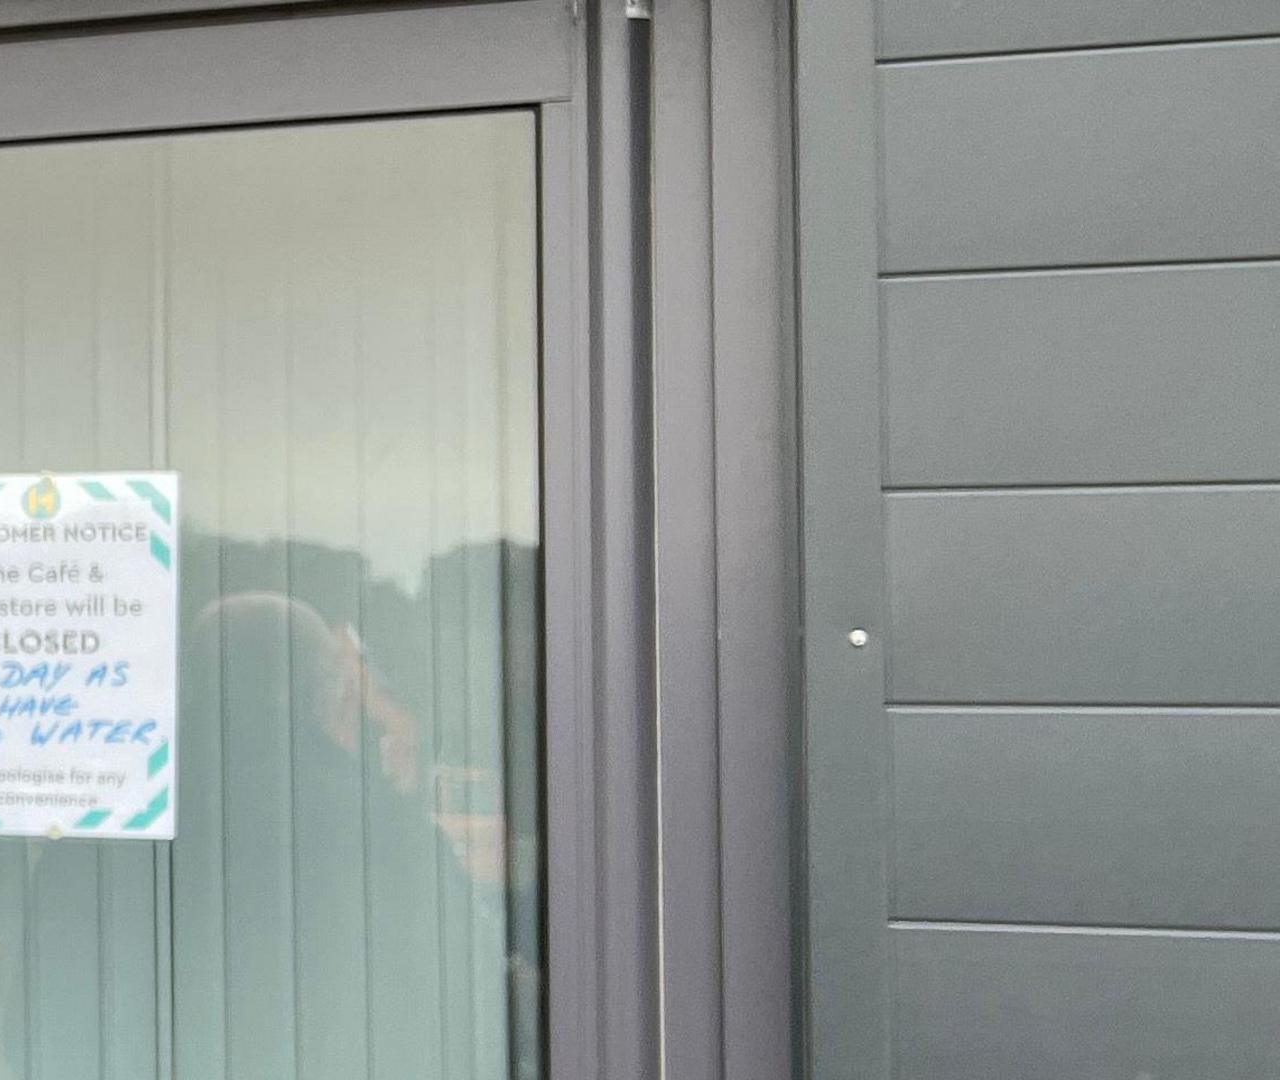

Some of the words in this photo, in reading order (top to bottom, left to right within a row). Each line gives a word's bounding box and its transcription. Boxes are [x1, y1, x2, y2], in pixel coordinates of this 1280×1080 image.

[63, 522, 148, 542] NOTICE
[28, 563, 81, 584] Café
[88, 564, 105, 584] &
[66, 597, 104, 617] will
[113, 597, 144, 618] be
[84, 660, 130, 688] AS
[29, 719, 158, 746] WATER
[69, 769, 91, 784] for
[97, 774, 127, 788] any
